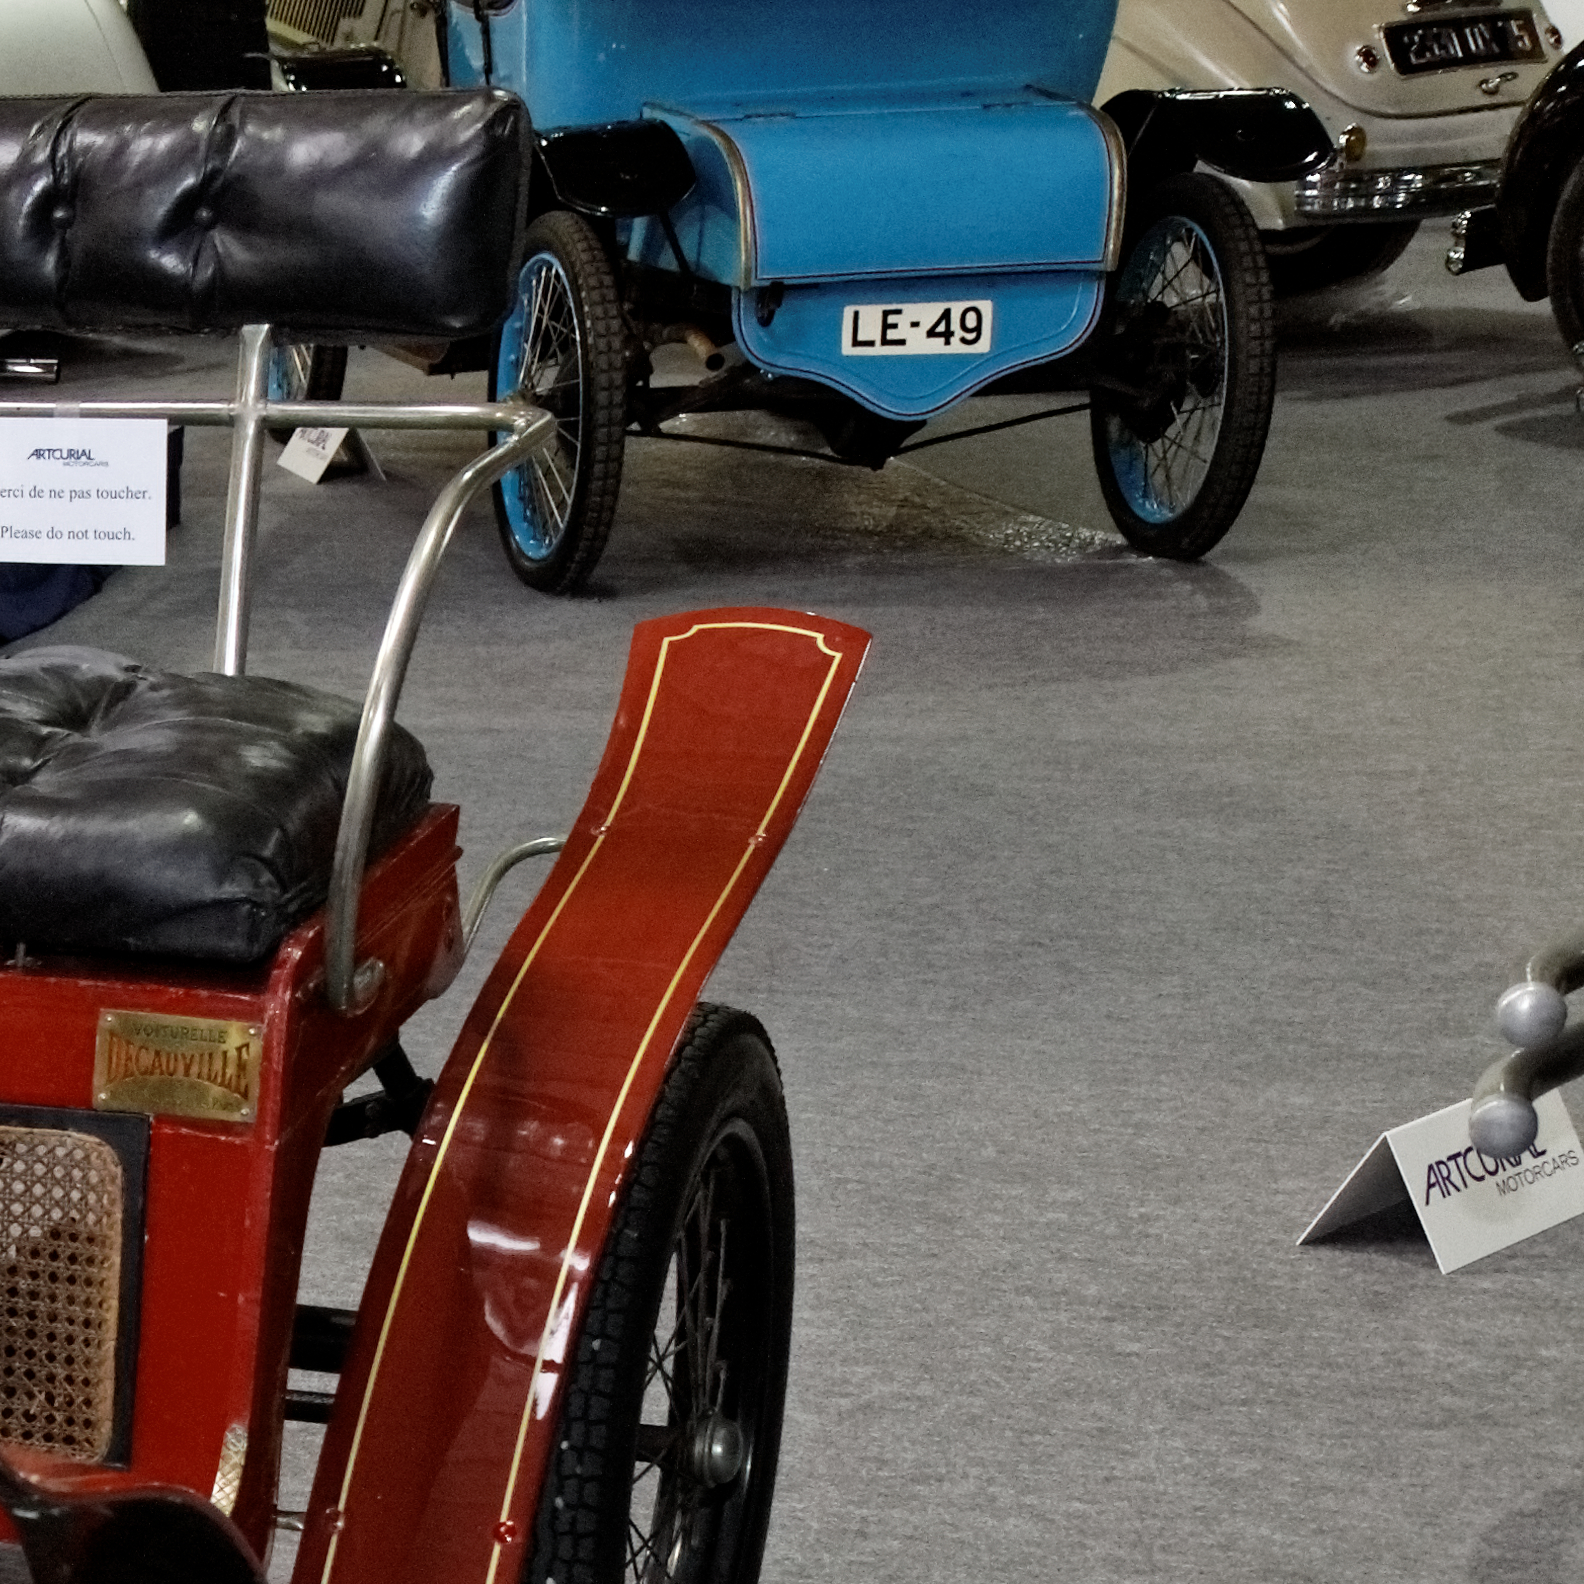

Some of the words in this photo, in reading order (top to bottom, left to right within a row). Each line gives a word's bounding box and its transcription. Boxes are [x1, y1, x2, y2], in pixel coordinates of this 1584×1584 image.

[851, 306, 983, 347] LE-49
[27, 448, 96, 461] ARTCURIAL
[28, 485, 45, 499] de
[49, 488, 65, 499] ne
[69, 488, 92, 502] pas
[96, 486, 152, 500] toucher.
[0, 525, 42, 539] Please
[46, 526, 63, 540] do
[67, 528, 90, 540] not
[93, 527, 136, 541] touch.
[133, 1023, 228, 1044] VOITURELLE
[105, 1030, 251, 1101] DECAUVILLE
[1495, 1149, 1580, 1197] MOTORCARS
